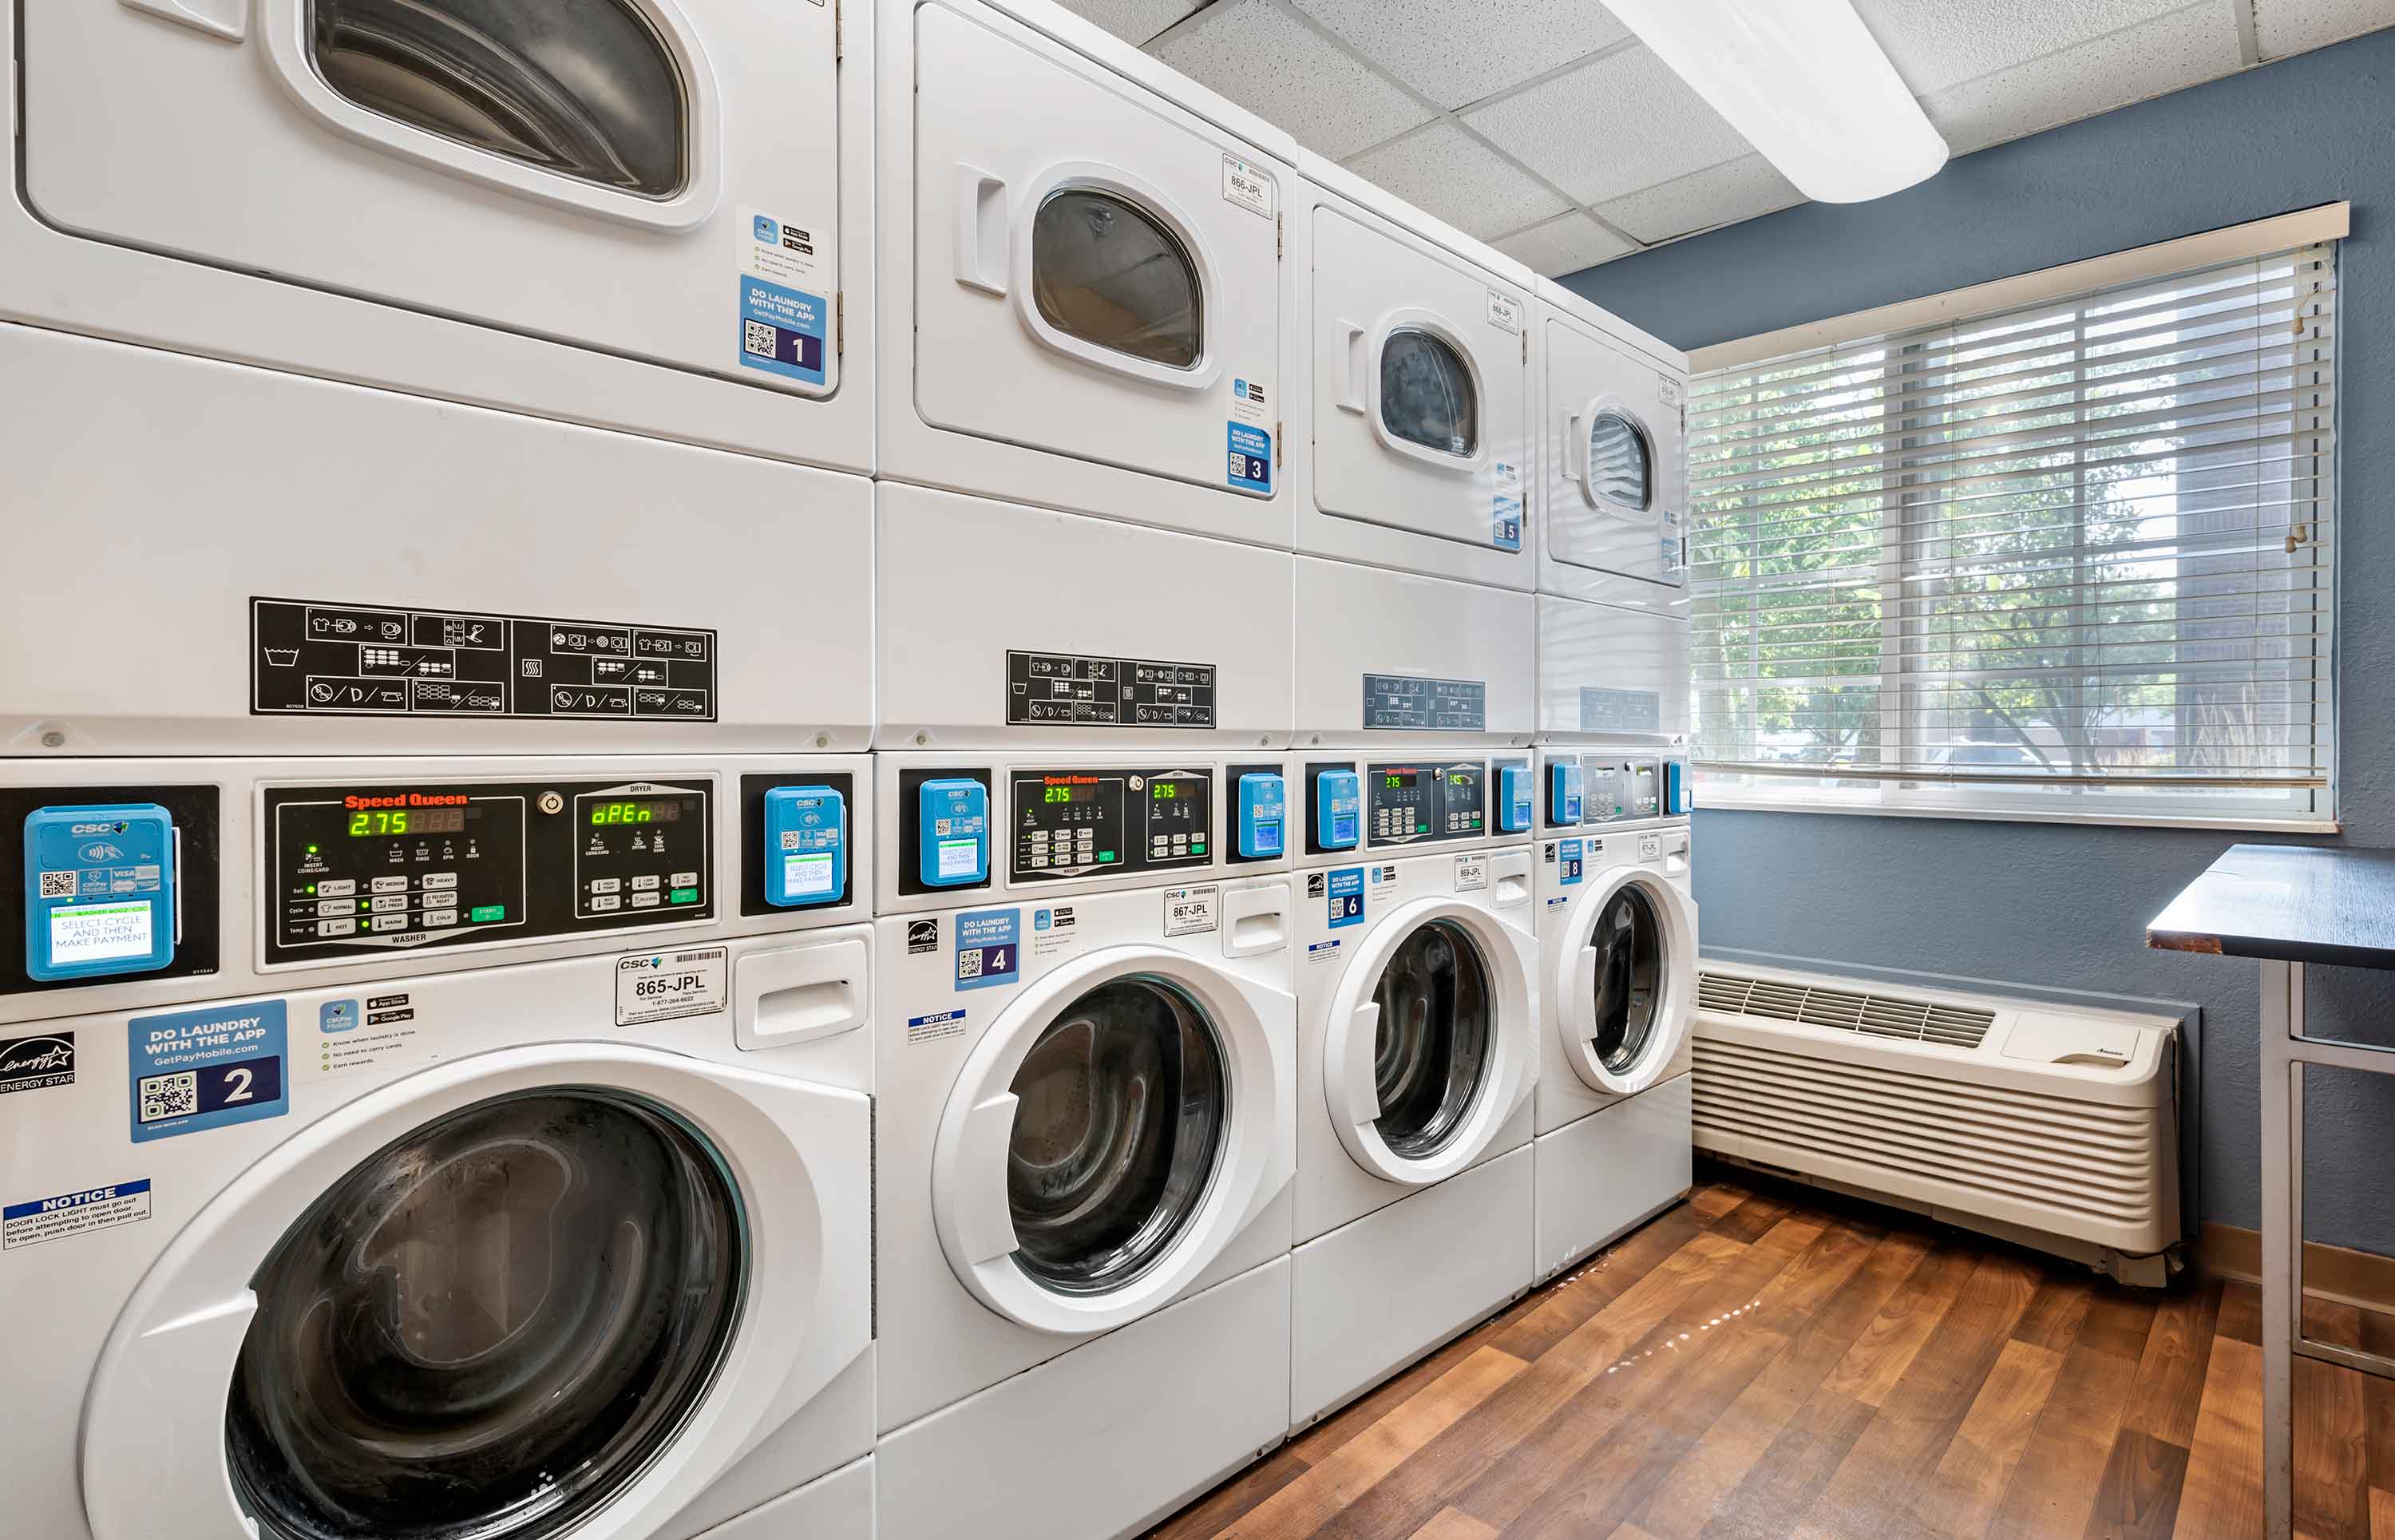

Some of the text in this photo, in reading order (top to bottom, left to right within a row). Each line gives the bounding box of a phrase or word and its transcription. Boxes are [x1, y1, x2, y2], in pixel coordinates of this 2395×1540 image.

[1231, 176, 1262, 198] 866-JPL
[749, 296, 815, 321] WITH THE APP
[752, 288, 812, 312] DO LAUNDRY
[753, 308, 810, 330] GetPayMobile.com
[793, 338, 803, 362] 1
[1252, 460, 1261, 479] 3
[1508, 525, 1514, 539] 5
[1044, 776, 1071, 786] Speed
[1045, 788, 1069, 802] 2.75
[1154, 785, 1174, 798] 2.75
[344, 793, 468, 810] Speed Queen
[71, 824, 110, 834] CSC
[351, 813, 406, 834] 2.75
[1573, 861, 1578, 875] 8
[1174, 905, 1207, 916] 867-JPL
[1349, 897, 1357, 914] 6
[61, 916, 141, 930] SELECT CYCLE
[977, 917, 1009, 927] LAUNDRY
[57, 932, 146, 948] MAKE PAYMENT
[73, 926, 133, 938] AND THEN
[392, 934, 426, 943] WASHER
[620, 959, 649, 969] CSC
[992, 949, 1006, 970] 4
[636, 976, 705, 996] 865-JPL
[923, 1012, 952, 1023] NOTICE
[150, 1017, 261, 1042] DO LAUNDRY
[145, 1028, 266, 1055] WITH THE APP
[154, 1045, 258, 1066] GetPayMobile.com
[0, 1074, 74, 1093] ENERGY STAR
[224, 1068, 253, 1103] 2
[42, 1187, 117, 1212] NOTICE
[6, 1218, 33, 1229] DOOR
[36, 1213, 60, 1223] LOCK
[62, 1207, 87, 1217] LIGHT
[89, 1203, 109, 1212] must
[6, 1226, 34, 1237] before
[35, 1217, 80, 1232] attempting
[91, 1210, 112, 1220] open
[113, 1205, 133, 1215] door.
[45, 1227, 65, 1237] push
[67, 1222, 86, 1231] door
[97, 1216, 116, 1225] then
[117, 1212, 132, 1222] pull
[133, 1209, 148, 1217] out.
